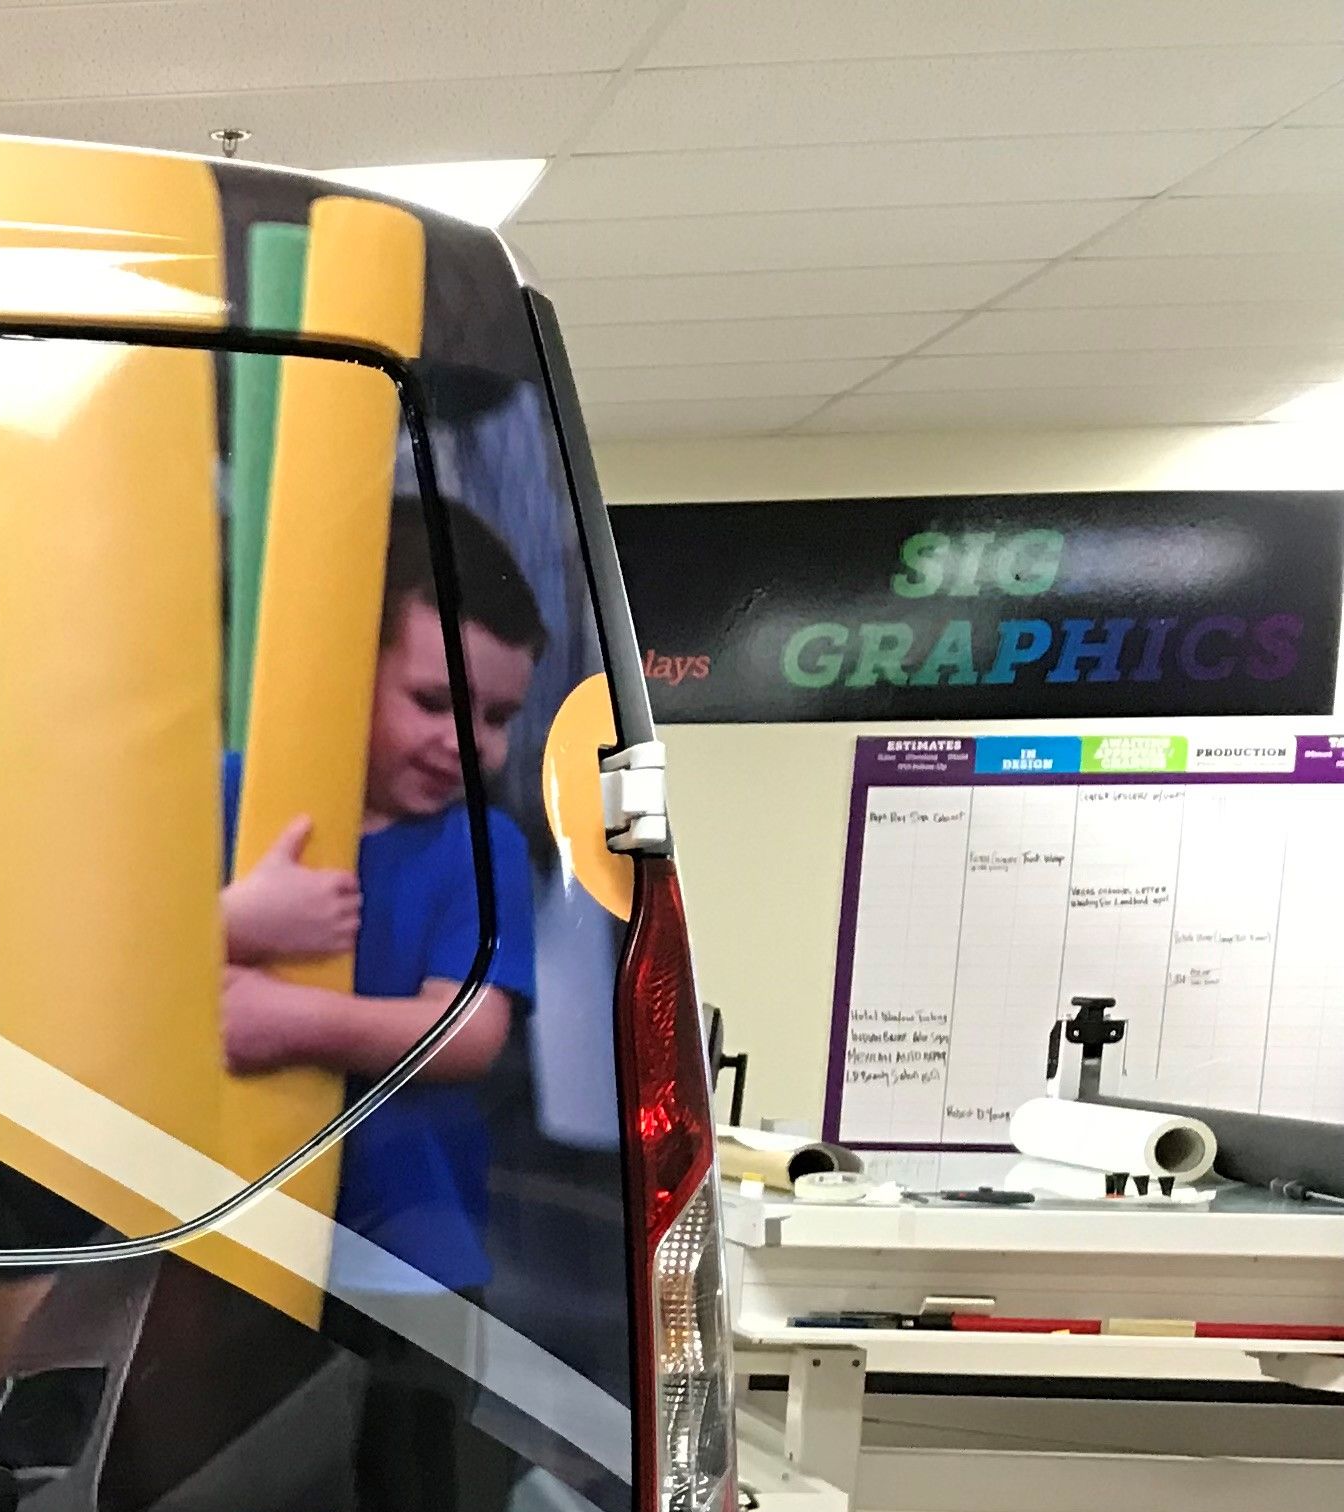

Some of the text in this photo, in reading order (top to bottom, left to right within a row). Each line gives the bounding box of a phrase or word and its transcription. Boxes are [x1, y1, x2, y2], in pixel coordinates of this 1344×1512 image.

[889, 528, 1066, 599] SIG
[782, 613, 1304, 689] GRAPHICS
[644, 648, 711, 687] lays
[886, 740, 962, 752] ESTIMATES
[1020, 748, 1037, 759] IN
[1195, 747, 1287, 758] PRODUCTION
[1002, 758, 1054, 770] DESIGN
